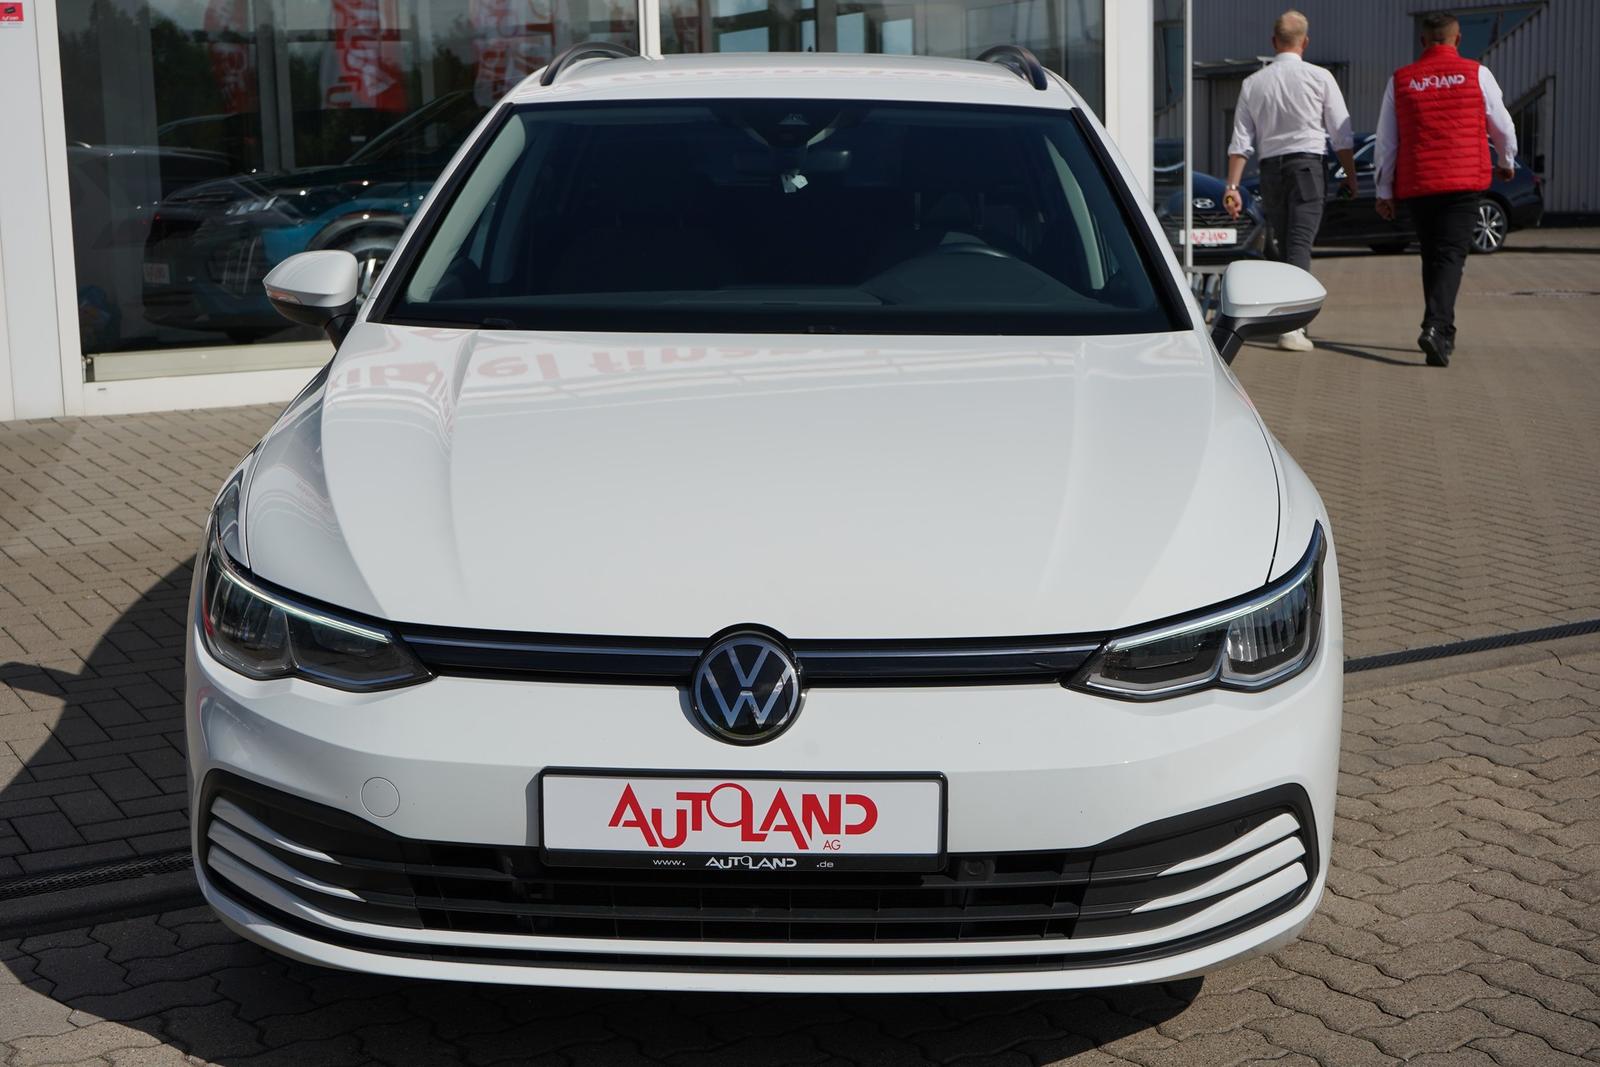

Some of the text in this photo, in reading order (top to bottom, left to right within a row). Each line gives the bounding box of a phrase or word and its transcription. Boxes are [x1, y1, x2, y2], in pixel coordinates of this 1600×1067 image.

[1409, 74, 1465, 91] AUTOLAND
[608, 782, 878, 850] AUTOLAND
[823, 840, 841, 850] AG
[705, 855, 797, 870] AUTOLAND
[816, 860, 834, 868] .de
